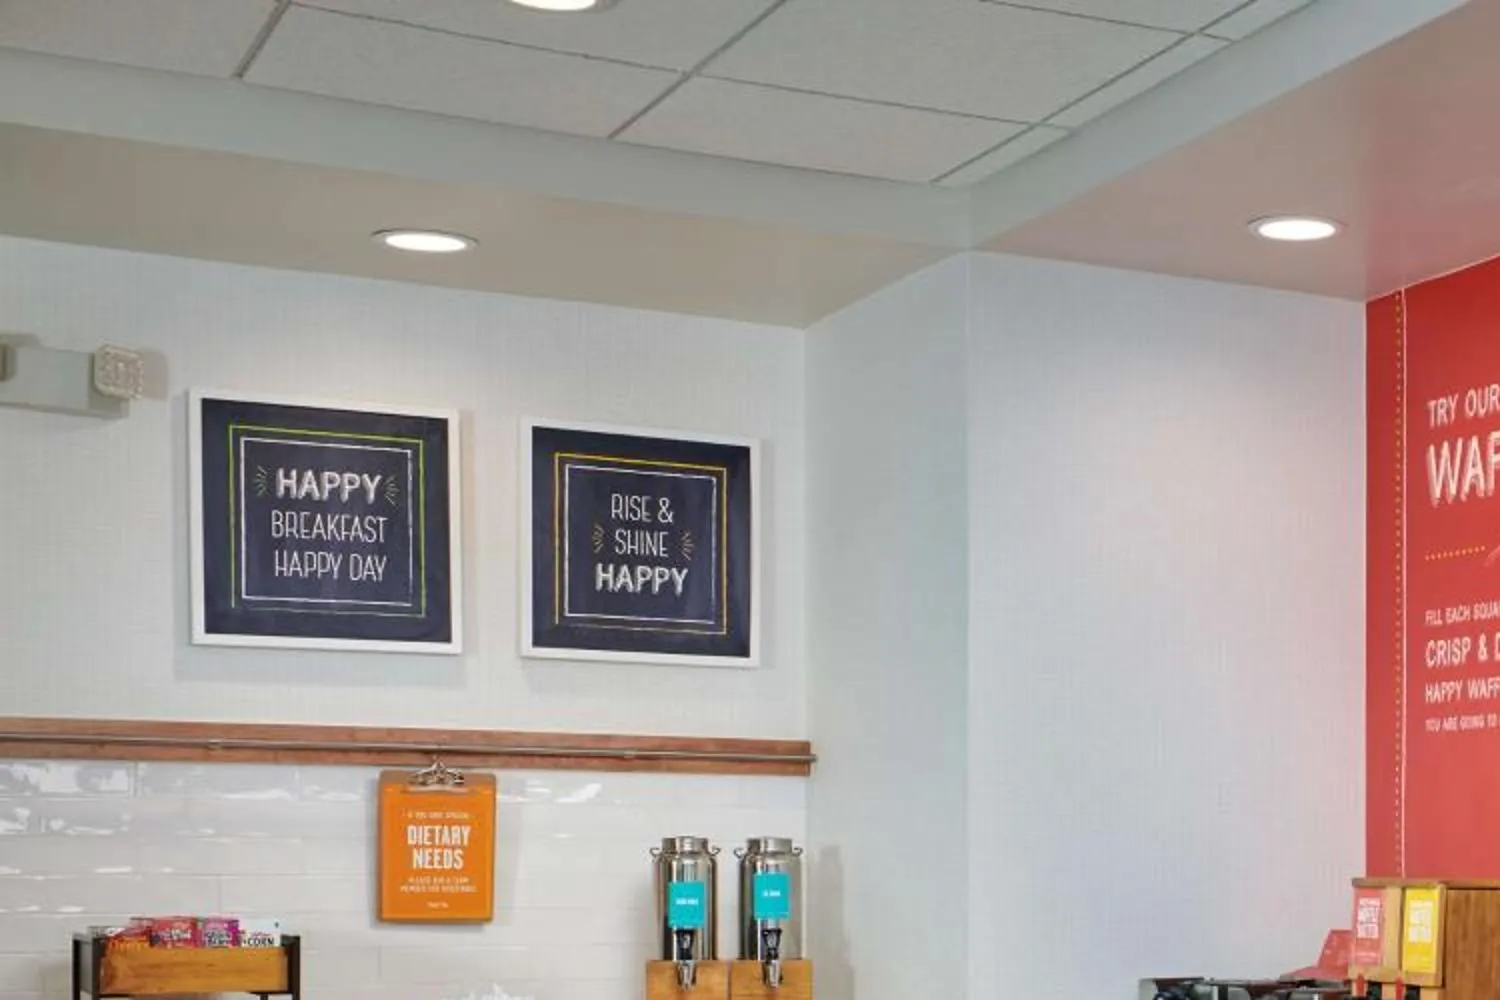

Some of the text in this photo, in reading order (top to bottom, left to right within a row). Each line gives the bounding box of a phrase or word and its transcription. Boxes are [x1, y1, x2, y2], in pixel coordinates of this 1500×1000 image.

[1427, 394, 1458, 428] TRY
[1464, 384, 1500, 419] OUR
[276, 467, 382, 504] HAPPY
[611, 493, 674, 524] RISE &
[271, 509, 388, 543] BREAKFAST
[614, 527, 669, 558] SHINE
[275, 550, 387, 583] HAPPY DAY
[595, 563, 689, 598] HAPPY
[1425, 607, 1443, 625] FILL
[1445, 604, 1471, 624] EACH
[1425, 636, 1472, 668] CRISP
[1477, 632, 1489, 662] &
[1425, 680, 1463, 704] HAPPY
[407, 824, 472, 847] DIETARY
[413, 847, 464, 870] NEEDS
